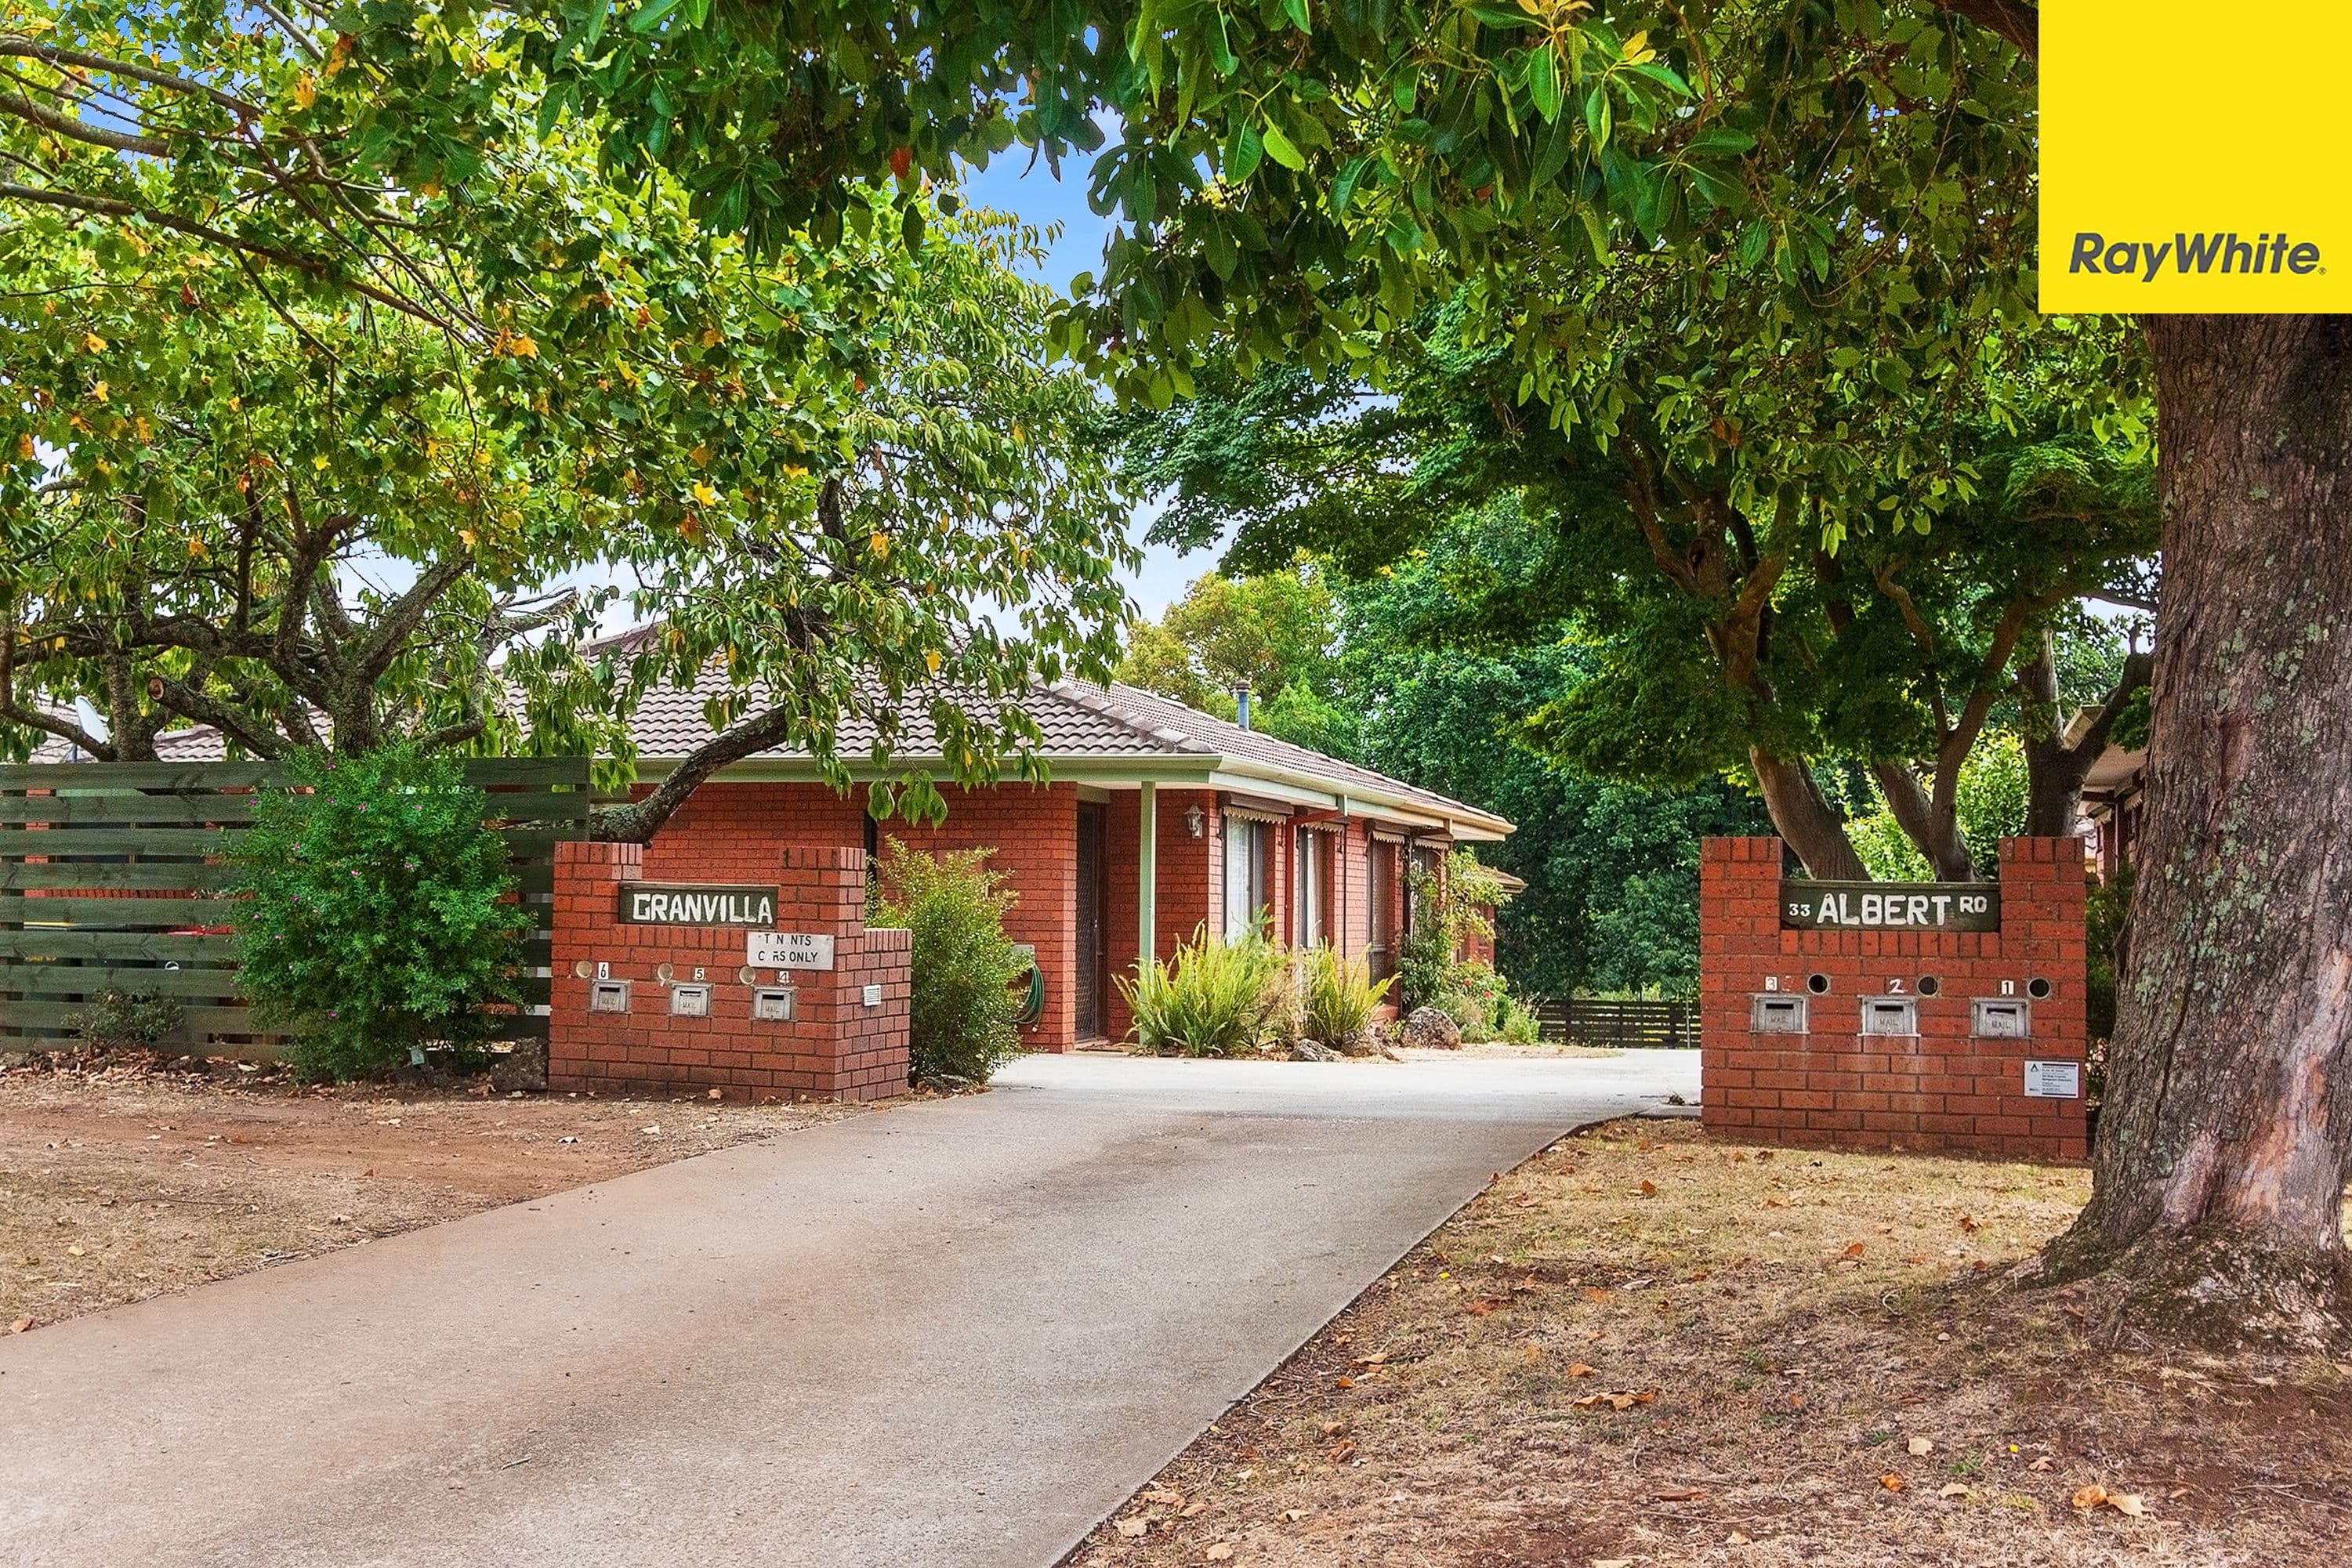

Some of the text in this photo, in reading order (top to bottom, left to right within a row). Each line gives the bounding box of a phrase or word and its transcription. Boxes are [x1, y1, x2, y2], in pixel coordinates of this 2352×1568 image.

[632, 893, 773, 925] GRANVILLA
[1788, 903, 1811, 918] 33
[1816, 893, 1952, 926] ALBERT
[788, 951, 818, 963] ONLY
[600, 964, 607, 979] 6
[696, 969, 704, 980] 5
[778, 972, 789, 983] 4
[1767, 977, 1776, 990] 3
[1888, 979, 1906, 994] 2
[1991, 1020, 2011, 1029] MAIL
